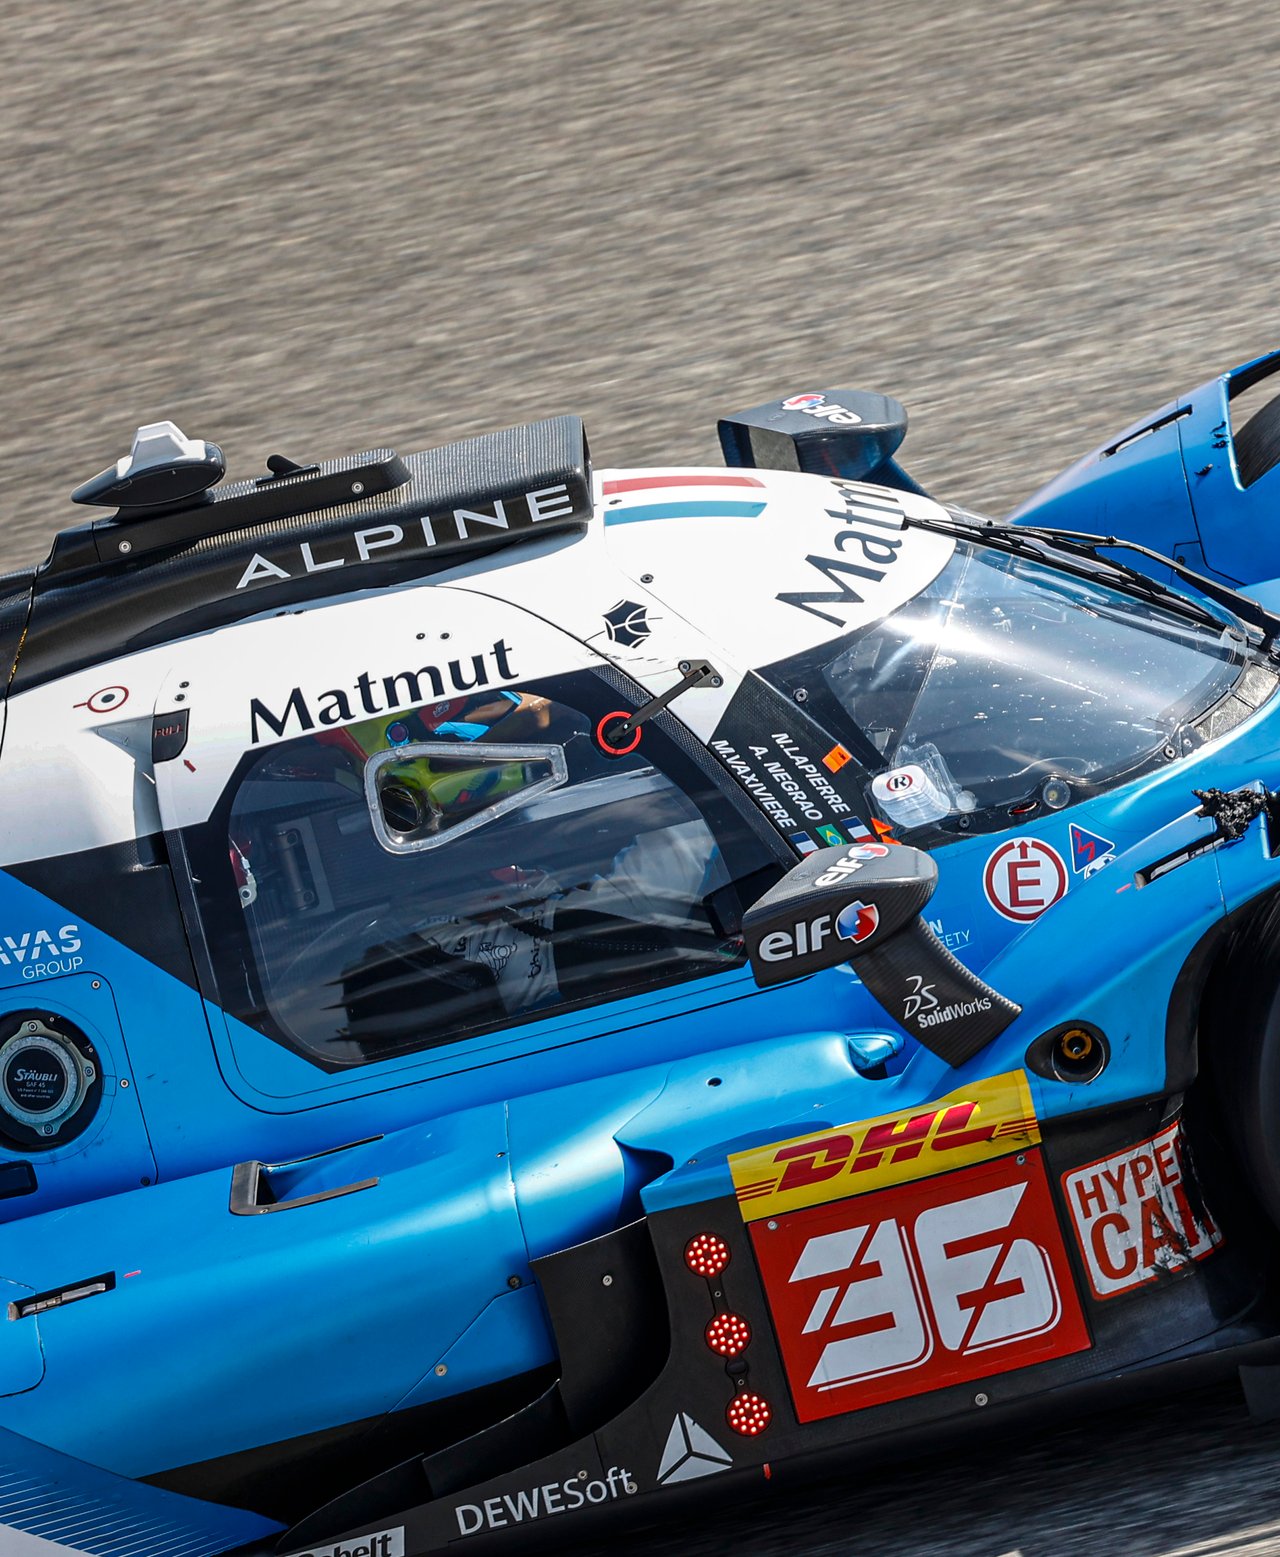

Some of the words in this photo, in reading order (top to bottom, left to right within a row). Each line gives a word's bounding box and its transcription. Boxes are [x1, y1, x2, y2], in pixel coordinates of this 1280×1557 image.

[802, 404, 862, 424] elf
[235, 484, 573, 590] ALPINE
[249, 638, 519, 744] Matmut
[764, 762, 823, 821] NEGRAO
[814, 857, 864, 887] elf
[758, 914, 832, 964] elf
[22, 956, 83, 979] GROUP
[917, 998, 992, 1029] SolidWorks
[14, 1068, 58, 1081] STÄUBLI
[773, 1101, 1000, 1193] DHL
[788, 1181, 1061, 1393] 36
[455, 1466, 633, 1535] DEWESoft
